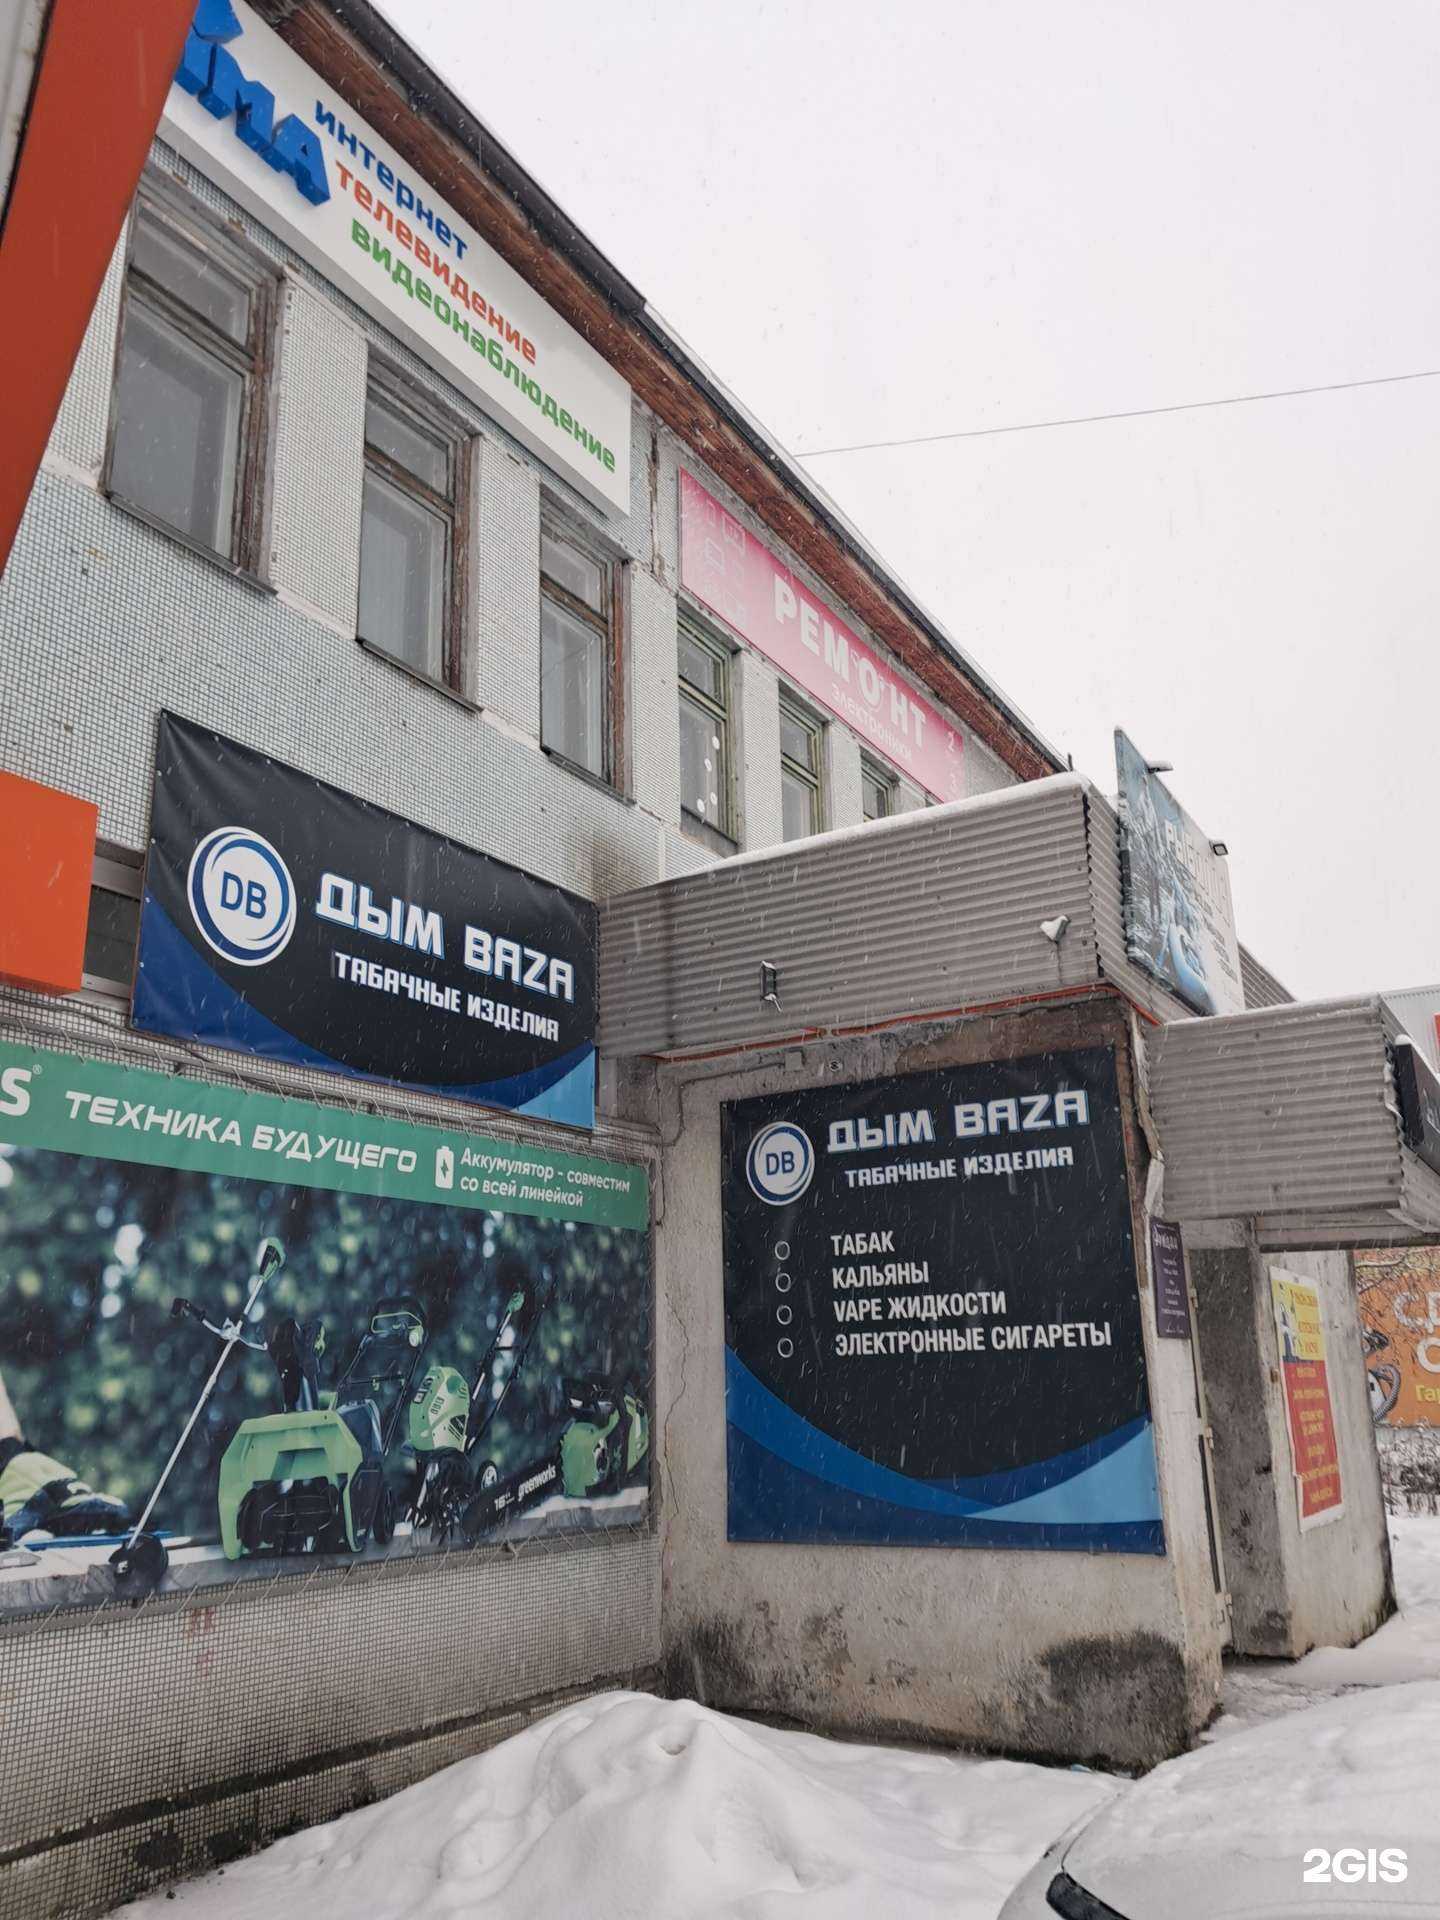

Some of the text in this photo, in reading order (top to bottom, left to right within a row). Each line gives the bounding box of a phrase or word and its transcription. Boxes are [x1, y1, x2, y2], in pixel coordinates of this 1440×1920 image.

[315, 100, 468, 260] интернет
[335, 160, 537, 366] телевидение
[350, 217, 617, 473] видеонаблюдение
[774, 572, 926, 748] РЕМОНТ
[220, 871, 268, 919] DB
[315, 872, 445, 960] ДЫМ
[334, 951, 559, 1042] ТАБАЧНЫЕ ИЗДЕЛИЯ
[65, 1091, 417, 1174] ТЕХНИКА БУДУЩЕГО
[826, 1108, 936, 1154] ДЫМ
[460, 1147, 554, 1182] Аккумулятор
[566, 1169, 630, 1193] совместим
[765, 1149, 796, 1176] DB
[844, 1146, 1074, 1189] ТАБАЧНЫЕ ИЗДЕЛИЯ
[460, 1176, 584, 1207] со всей линейкой
[830, 1231, 895, 1257] ТАБАК
[831, 1261, 930, 1290] КАЛЬЯНЫ
[832, 1291, 1007, 1323] VAPE ЖИДКОСТИ
[834, 1321, 1113, 1357] ЭЛЕКТРОННЫЕ СИГАРЕТЫ
[518, 1463, 557, 1502] greenworks
